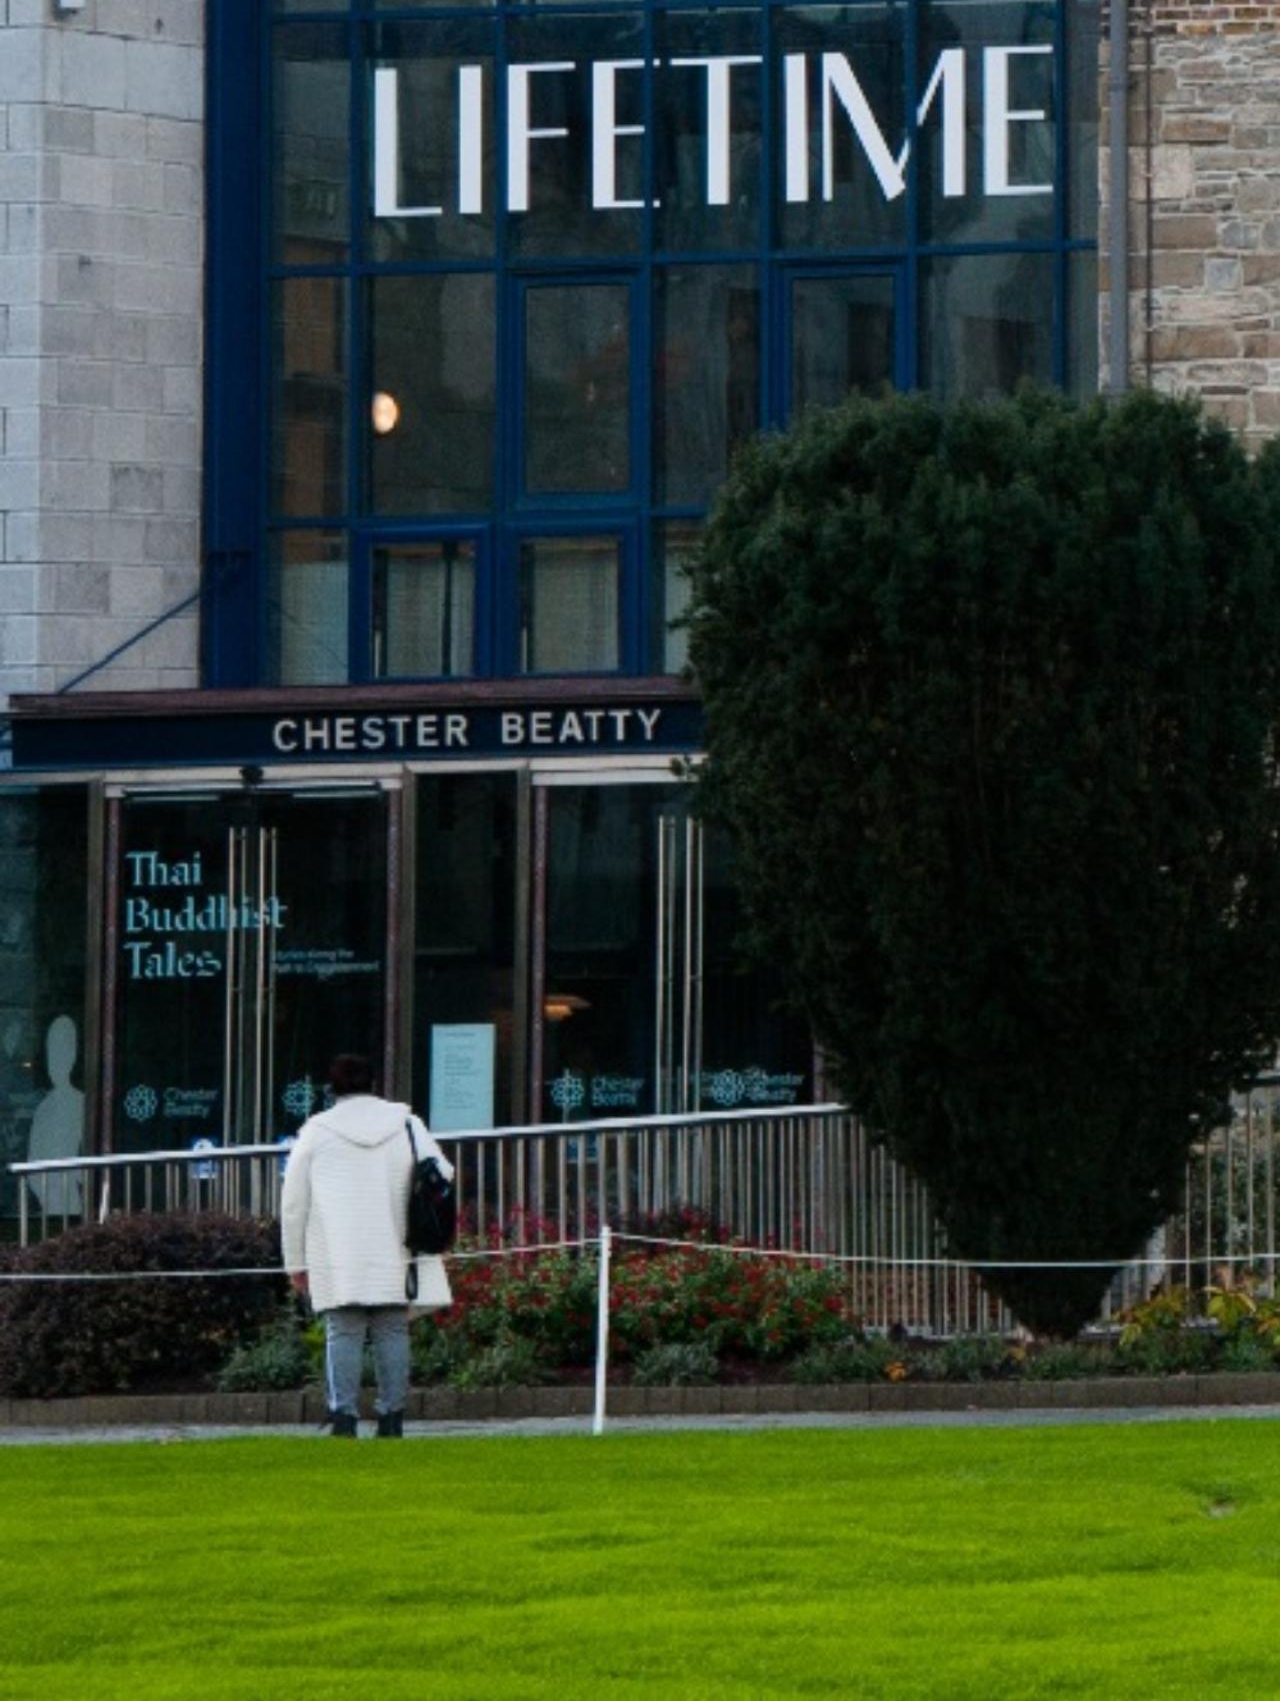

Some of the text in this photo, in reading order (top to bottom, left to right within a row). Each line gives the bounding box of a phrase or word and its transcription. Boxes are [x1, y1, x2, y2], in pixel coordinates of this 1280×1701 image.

[373, 44, 1054, 218] LIFETIME
[272, 708, 662, 752] CHESTER BEATTY
[125, 850, 203, 886] Thai
[126, 895, 288, 932] Buddhist
[124, 940, 222, 979] Tales
